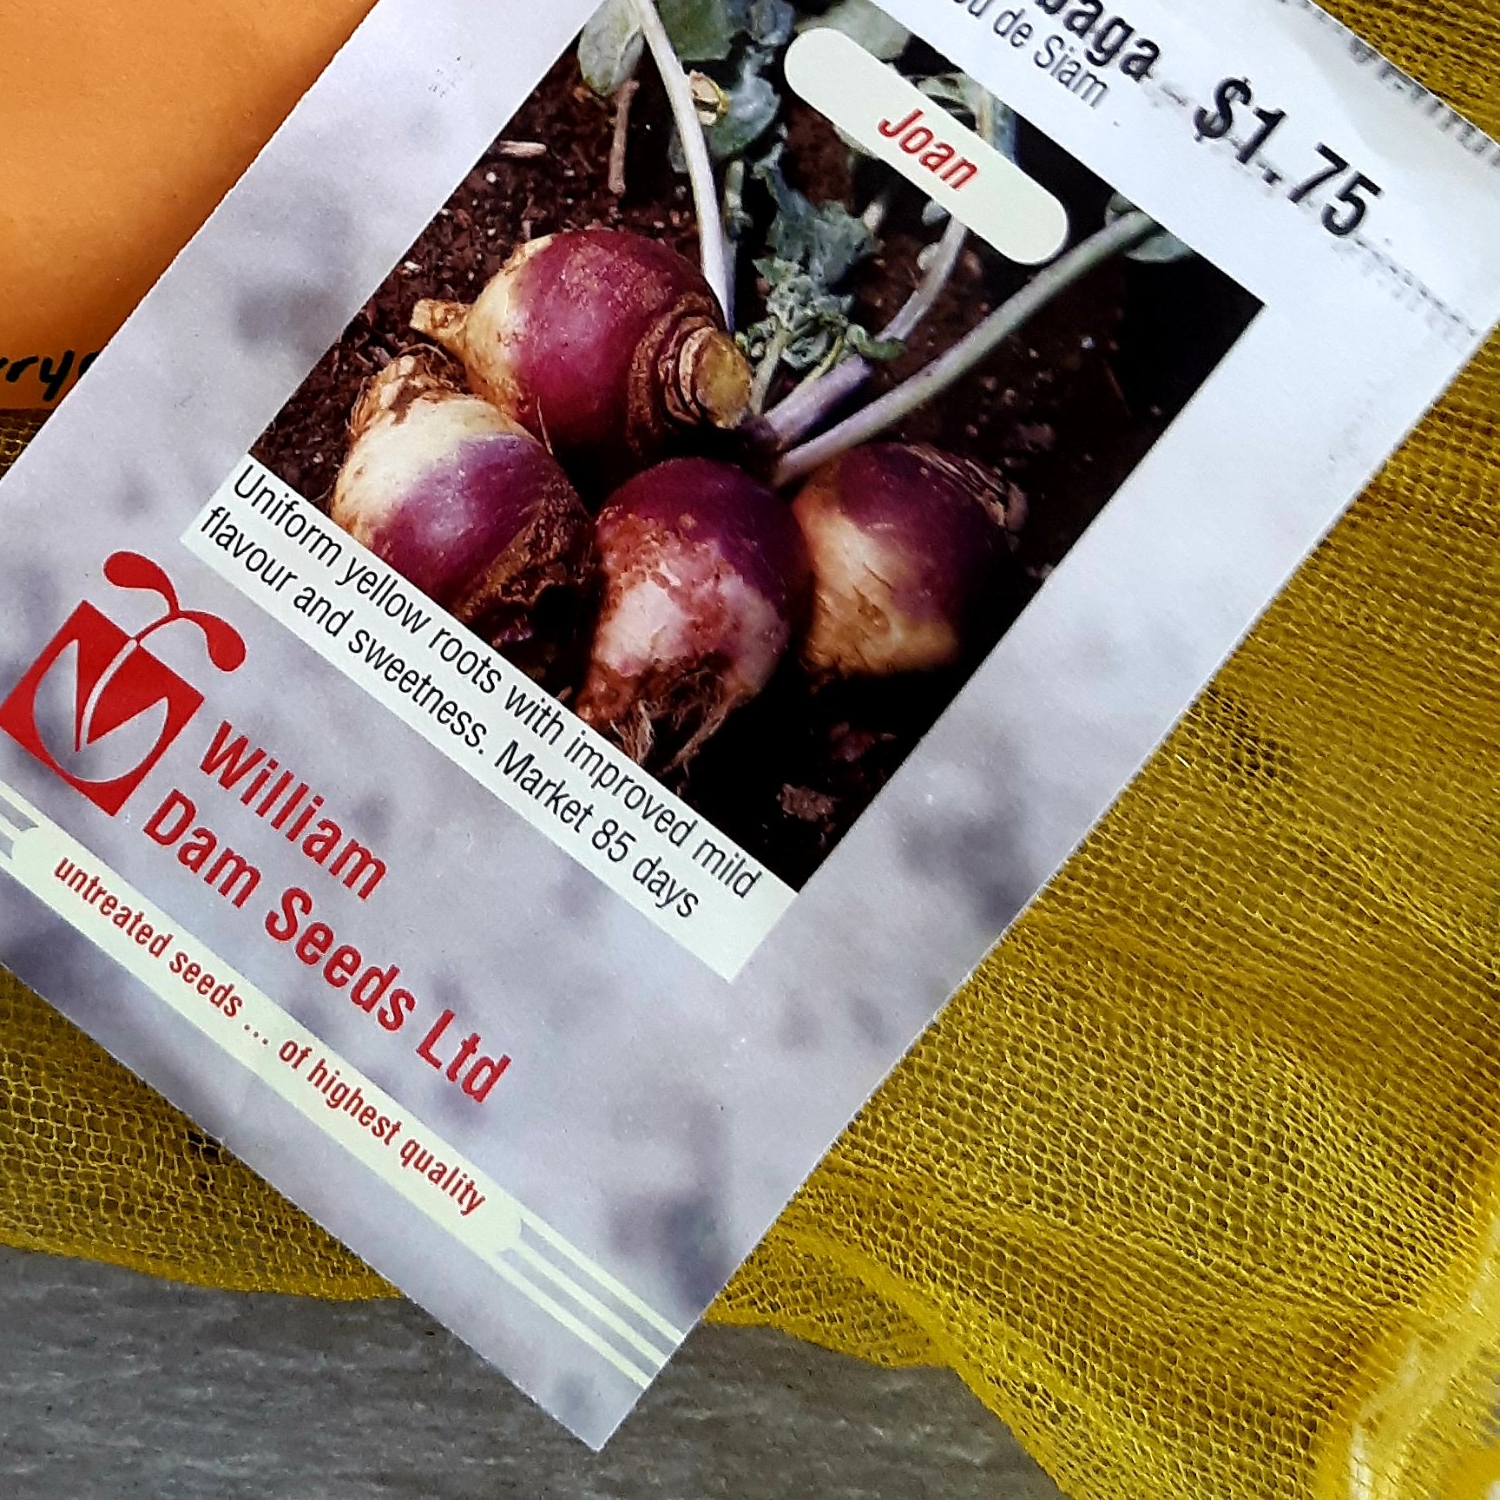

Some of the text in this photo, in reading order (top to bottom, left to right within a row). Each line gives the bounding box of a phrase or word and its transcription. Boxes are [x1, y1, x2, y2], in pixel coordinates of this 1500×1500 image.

[878, 107, 980, 191] Joan
[992, 4, 1030, 50] de
[1033, 31, 1110, 108] Siam
[1192, 76, 1384, 237] $1.75
[200, 505, 700, 919] flavour and sweetness. Market 85 days
[233, 464, 763, 899] Uniform yellow roots with improved mild
[200, 720, 388, 900] William
[54, 855, 175, 959] untreated
[169, 948, 244, 1019] seeds
[278, 1037, 314, 1070] of
[306, 1054, 401, 1147] highest
[400, 1136, 486, 1217] quality
[142, 789, 514, 1104] Dam Seeds Ltd
